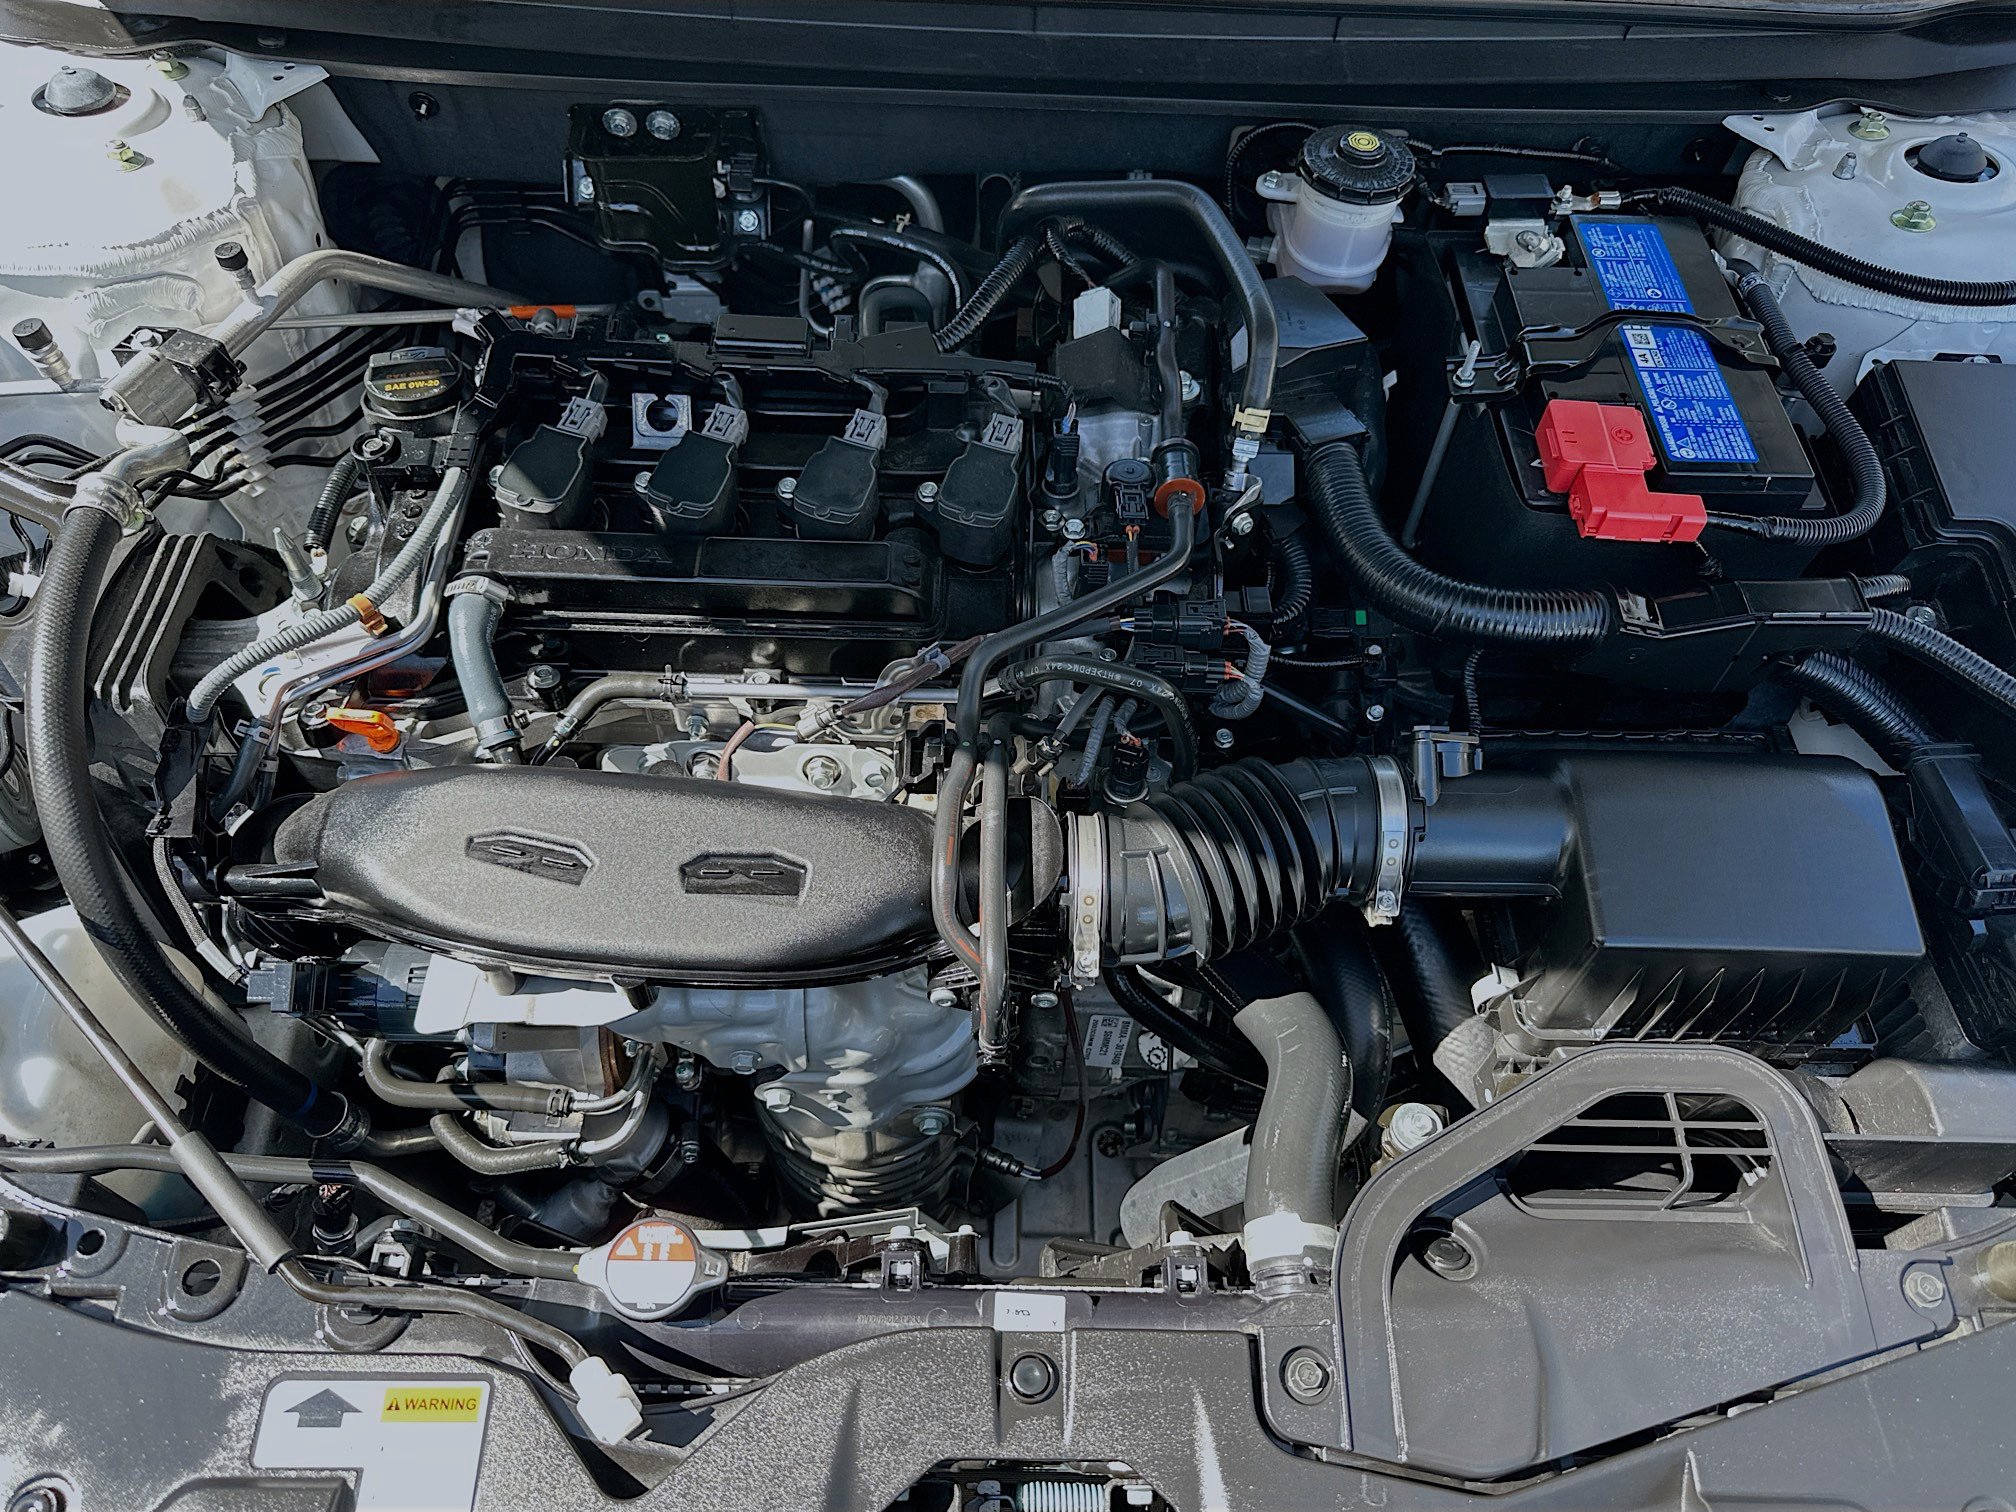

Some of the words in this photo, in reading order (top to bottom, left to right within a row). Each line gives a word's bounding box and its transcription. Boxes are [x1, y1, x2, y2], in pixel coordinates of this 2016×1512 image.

[384, 382, 407, 392] SAE
[408, 379, 440, 390] 0W-20
[509, 544, 673, 563] HONDA
[404, 1397, 477, 1411] WARNING
